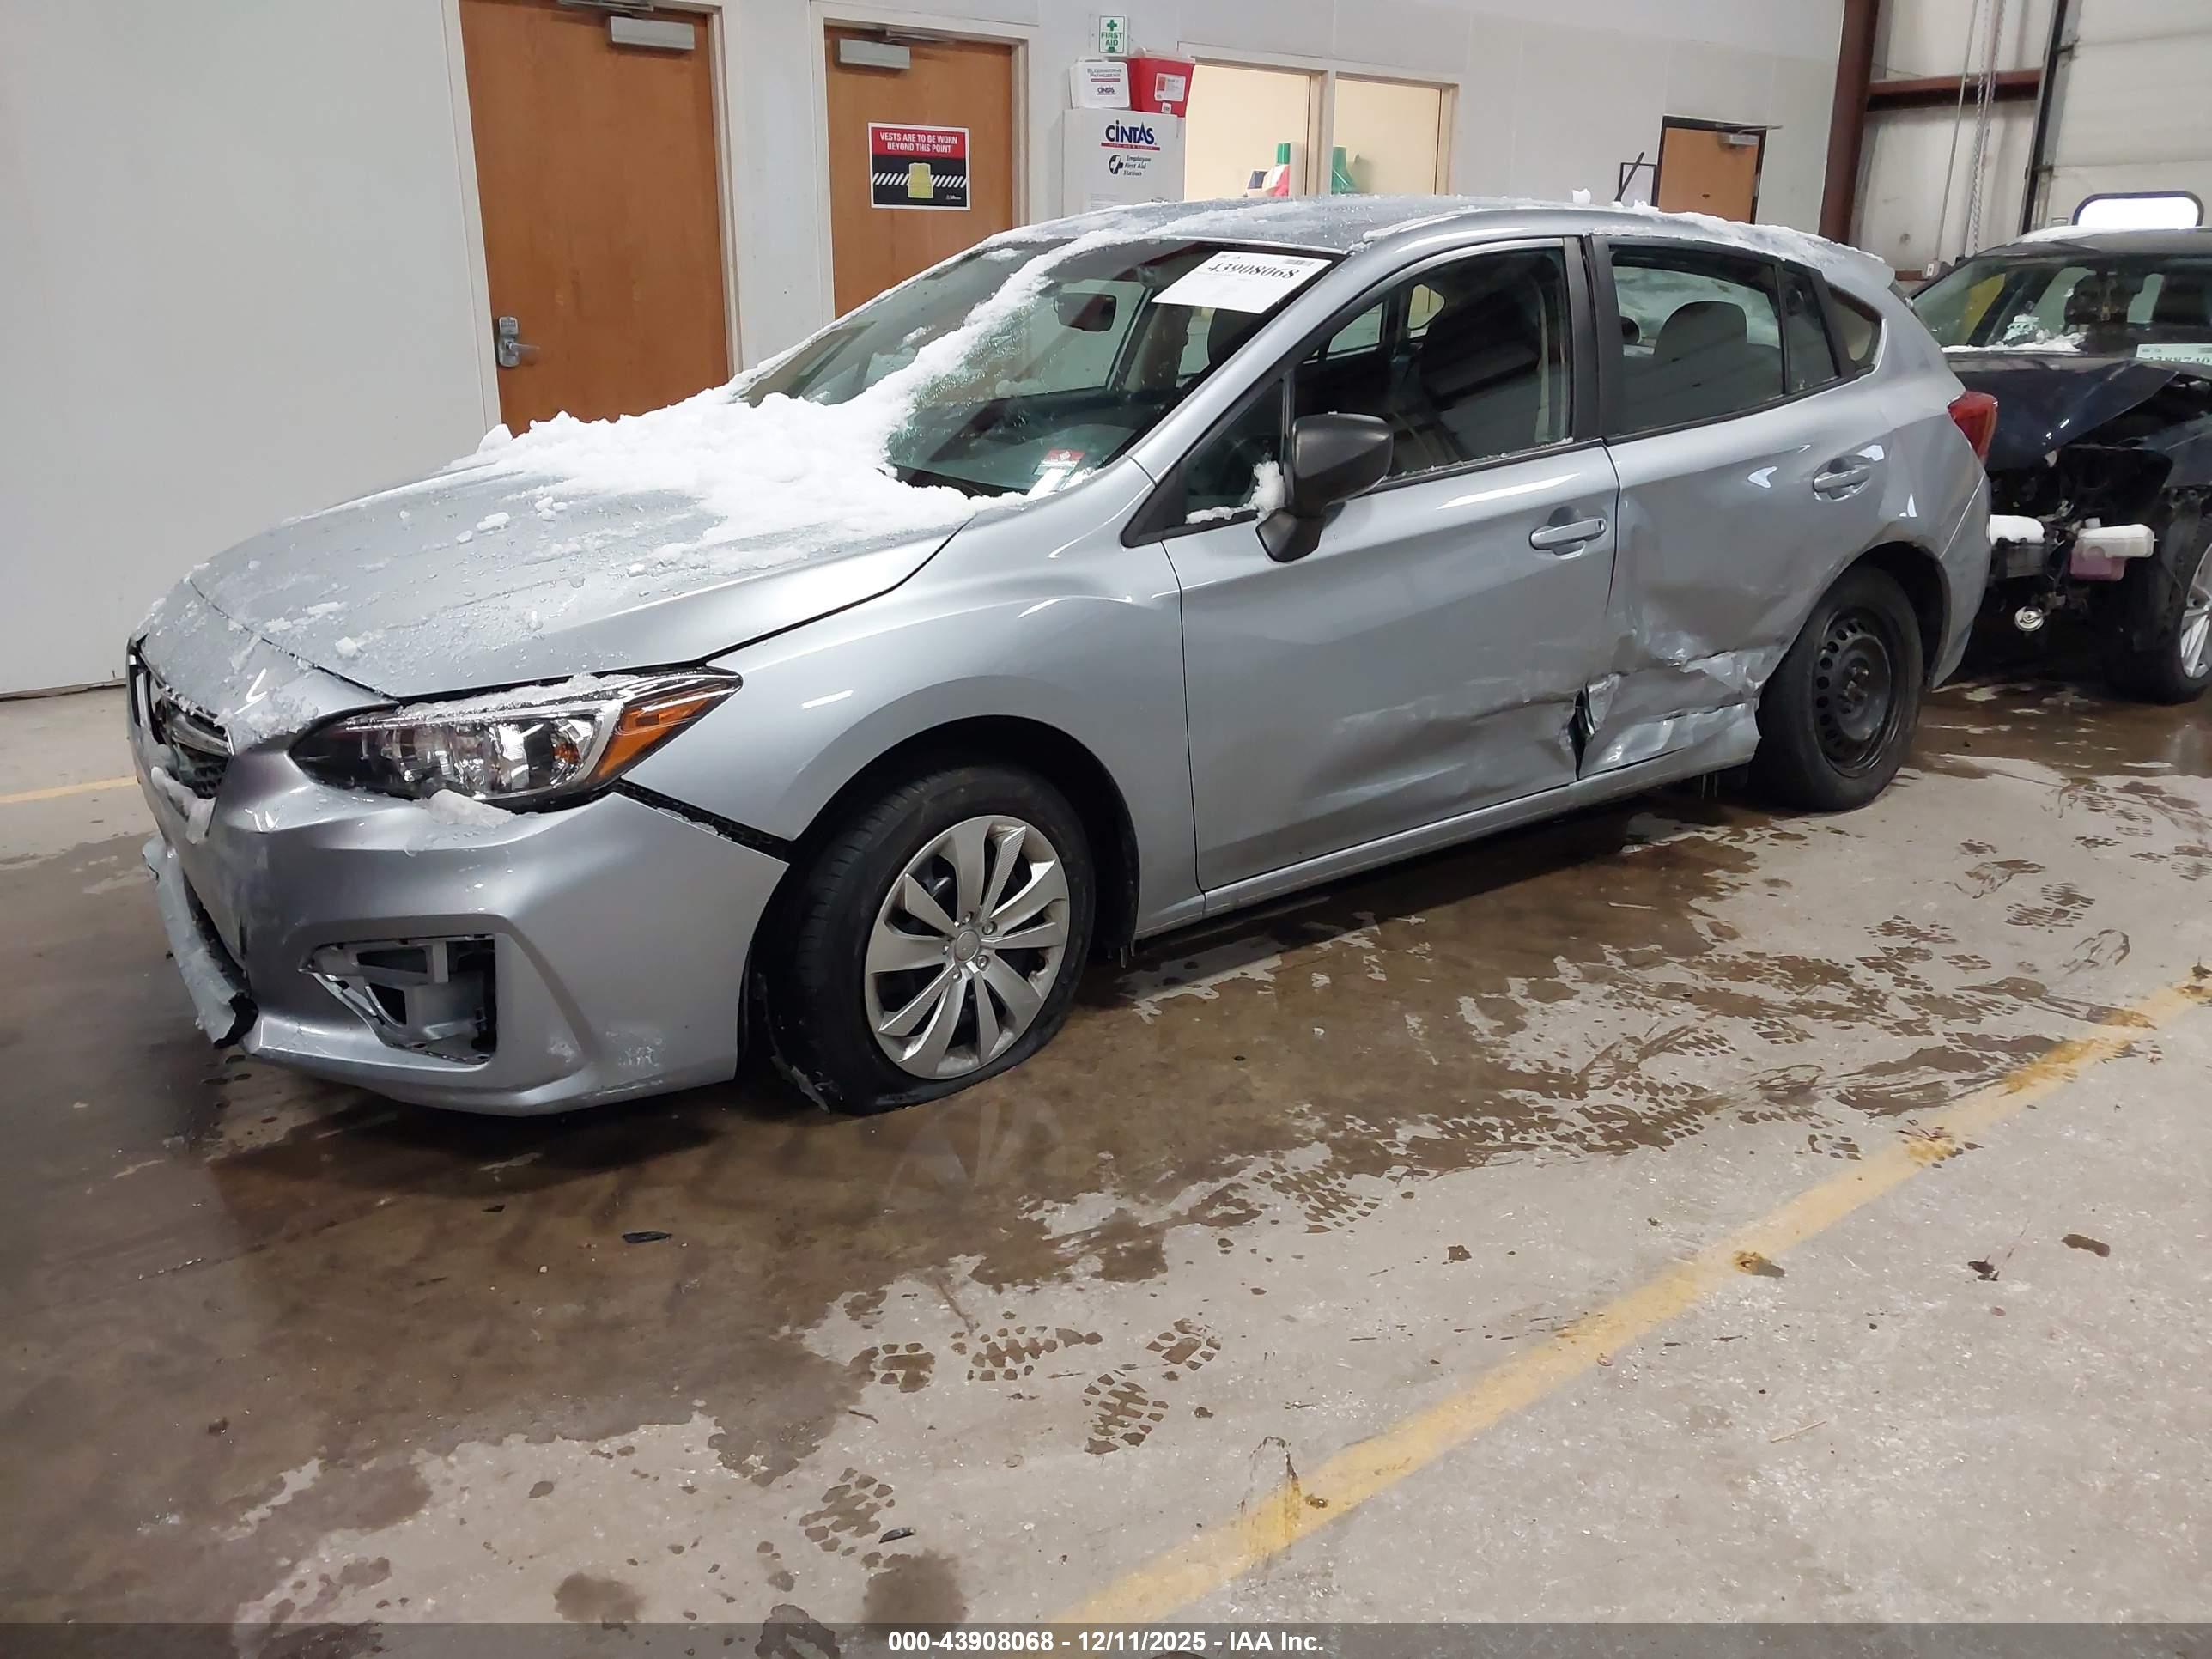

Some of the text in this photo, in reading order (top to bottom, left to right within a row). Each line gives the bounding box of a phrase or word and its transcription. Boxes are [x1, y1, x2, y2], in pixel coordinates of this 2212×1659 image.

[879, 131, 957, 144] VESTS ARE TO BE WORN
[887, 142, 951, 153] BEYOND THIS POINT
[1207, 262, 1300, 279] 43908068
